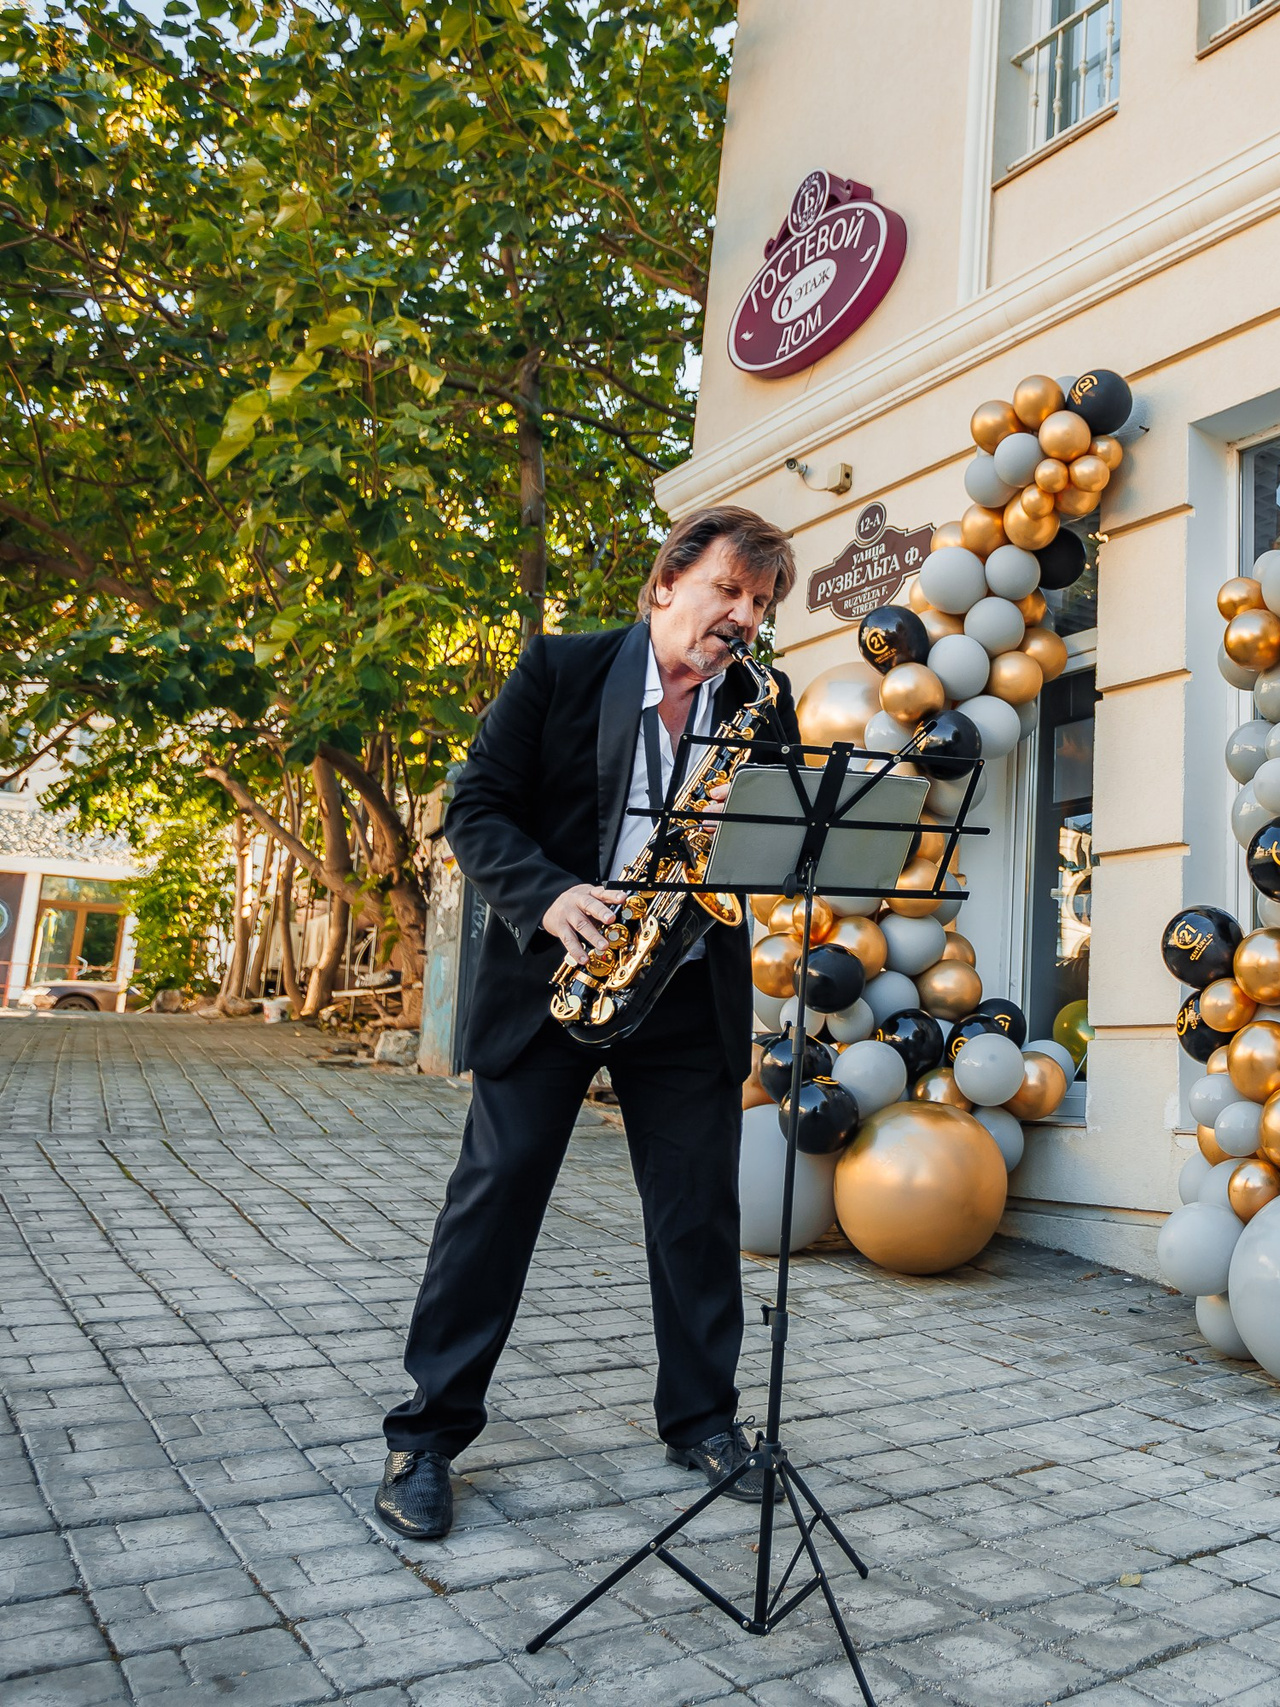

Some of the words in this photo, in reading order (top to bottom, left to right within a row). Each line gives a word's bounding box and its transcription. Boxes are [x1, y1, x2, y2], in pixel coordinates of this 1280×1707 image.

[750, 209, 866, 313] ГОСТЕВОЙ
[778, 282, 793, 319] 6
[794, 267, 831, 302] ЭТАЖ
[775, 304, 823, 359] ДОМ
[816, 554, 901, 601] РУЗВЕЛЬТА
[904, 545, 923, 566] Ф.
[851, 543, 886, 570] улица
[843, 588, 881, 611] RUZVELTA
[851, 599, 879, 617] STREET
